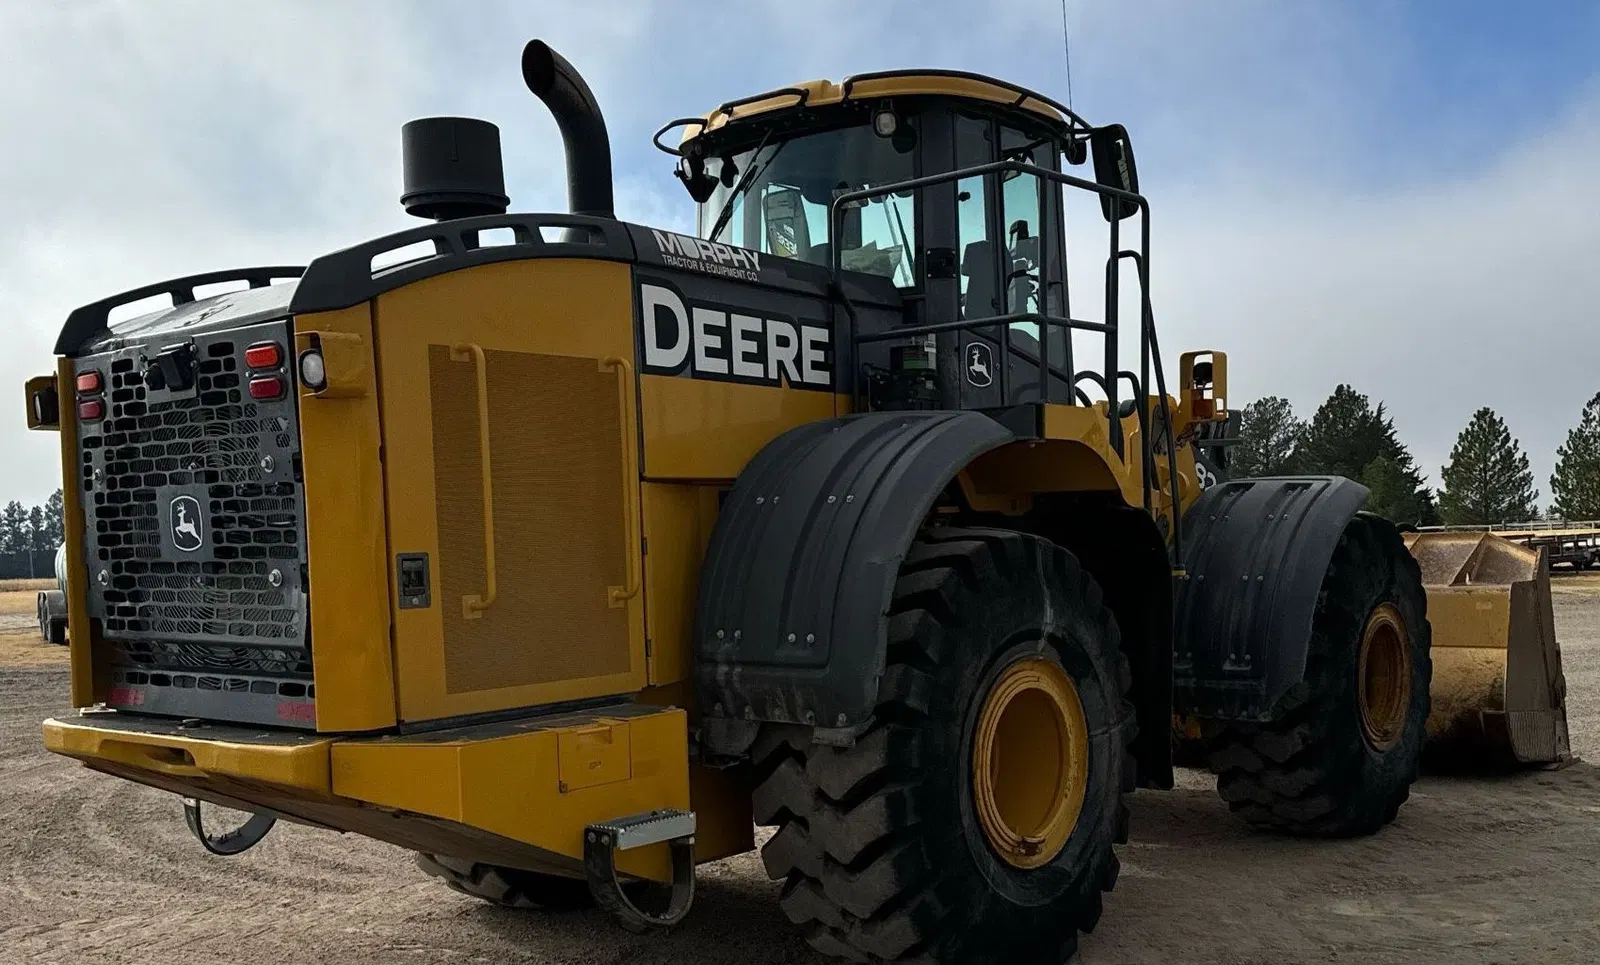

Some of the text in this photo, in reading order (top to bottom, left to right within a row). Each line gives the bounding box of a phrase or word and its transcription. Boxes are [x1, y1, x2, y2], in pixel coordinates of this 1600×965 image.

[652, 229, 761, 271] MURPHY
[662, 254, 699, 270] TRACTOR
[700, 261, 705, 272] &
[706, 263, 746, 280] EQUIPMENT
[641, 283, 830, 385] DEERE
